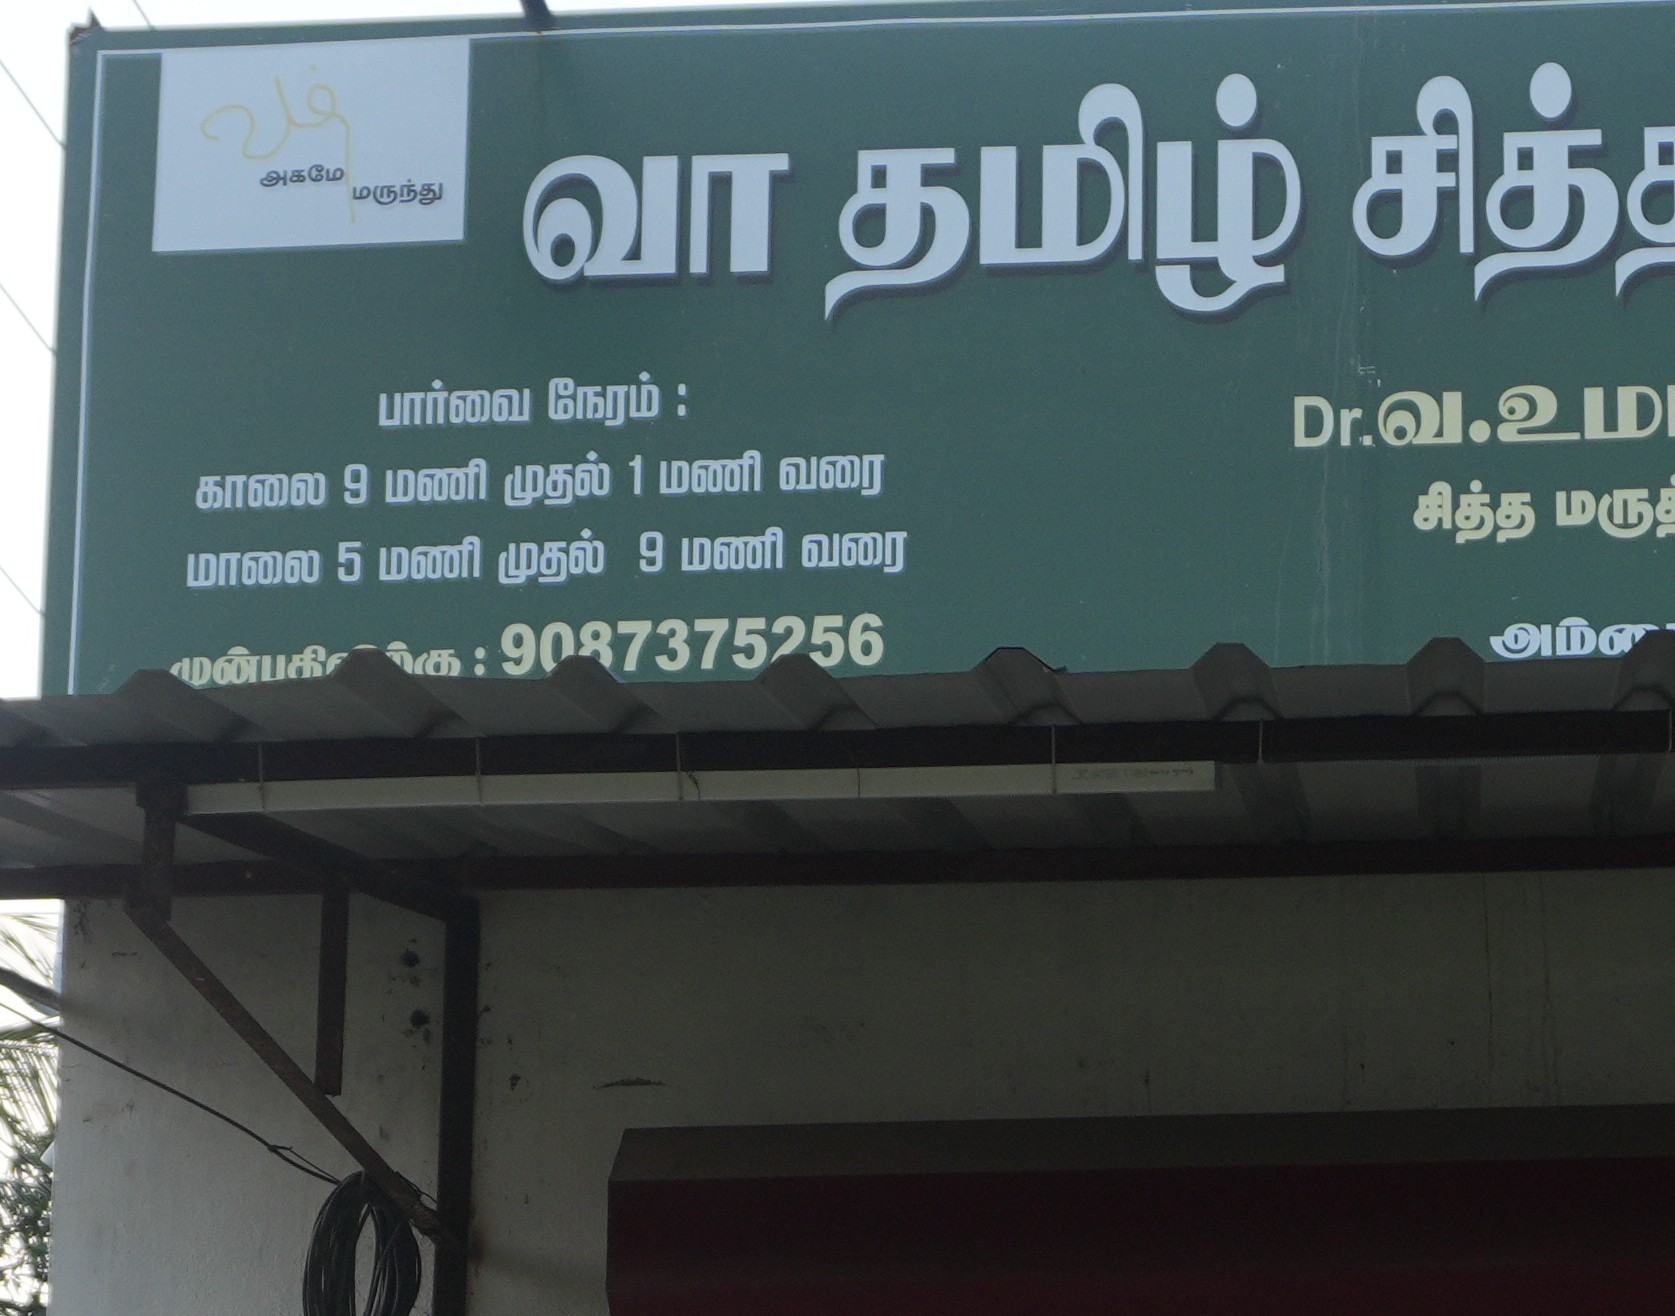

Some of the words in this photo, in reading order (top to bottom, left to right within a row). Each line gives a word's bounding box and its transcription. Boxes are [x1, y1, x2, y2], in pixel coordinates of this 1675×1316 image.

[260, 164, 344, 187] அகமே
[353, 179, 443, 205] மருந்து
[523, 153, 789, 280] வா
[825, 74, 1300, 319] தமிழ்
[379, 379, 530, 426] பார்வை
[548, 372, 659, 426] நேரம்
[196, 473, 326, 509] காலை
[344, 464, 367, 504] 9
[386, 458, 486, 502] மணி
[504, 451, 610, 506] முதல்
[629, 455, 641, 494] 1
[660, 450, 761, 493] மணி
[780, 454, 884, 495] வரை
[1413, 480, 1535, 543] சித்த
[187, 550, 320, 586] மாலை
[338, 542, 361, 581] 5
[379, 536, 480, 580] மணி
[499, 528, 604, 584] முதல்
[640, 532, 663, 572] 9
[682, 527, 783, 571] மணி
[802, 531, 907, 572] வரை
[499, 612, 886, 678] 9087375256
